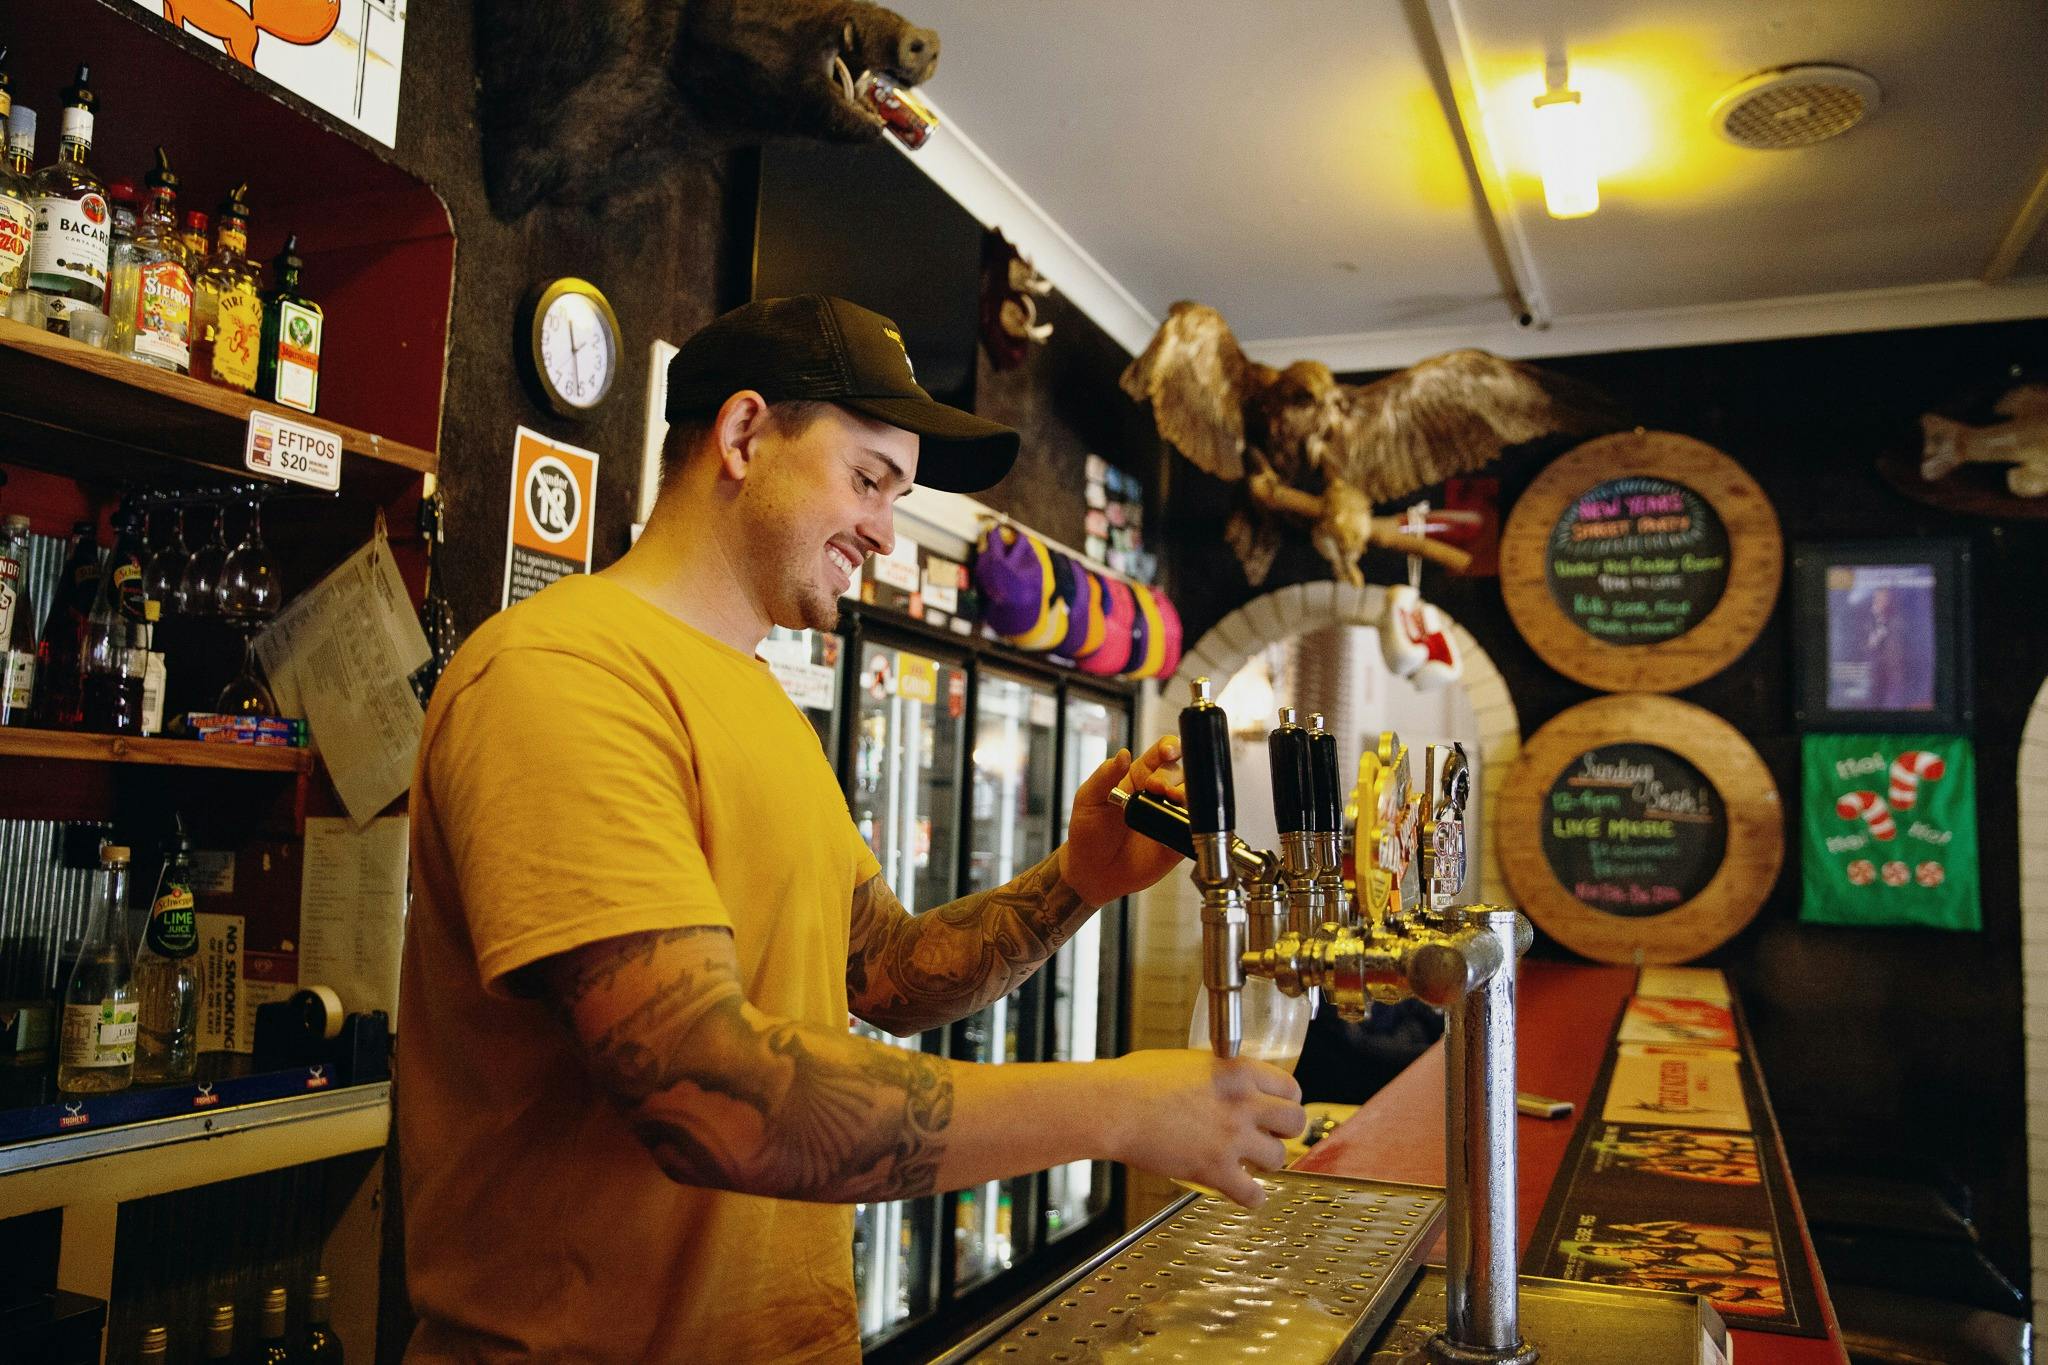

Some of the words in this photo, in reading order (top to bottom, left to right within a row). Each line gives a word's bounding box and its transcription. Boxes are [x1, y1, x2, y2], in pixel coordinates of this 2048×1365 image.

[278, 429, 335, 459] EFTPOS
[280, 451, 307, 472] $20
[537, 487, 567, 529] 18
[163, 912, 192, 925] LIME
[167, 925, 191, 934] JUICE
[227, 925, 237, 953] NO
[224, 960, 237, 1049] SMOKING
